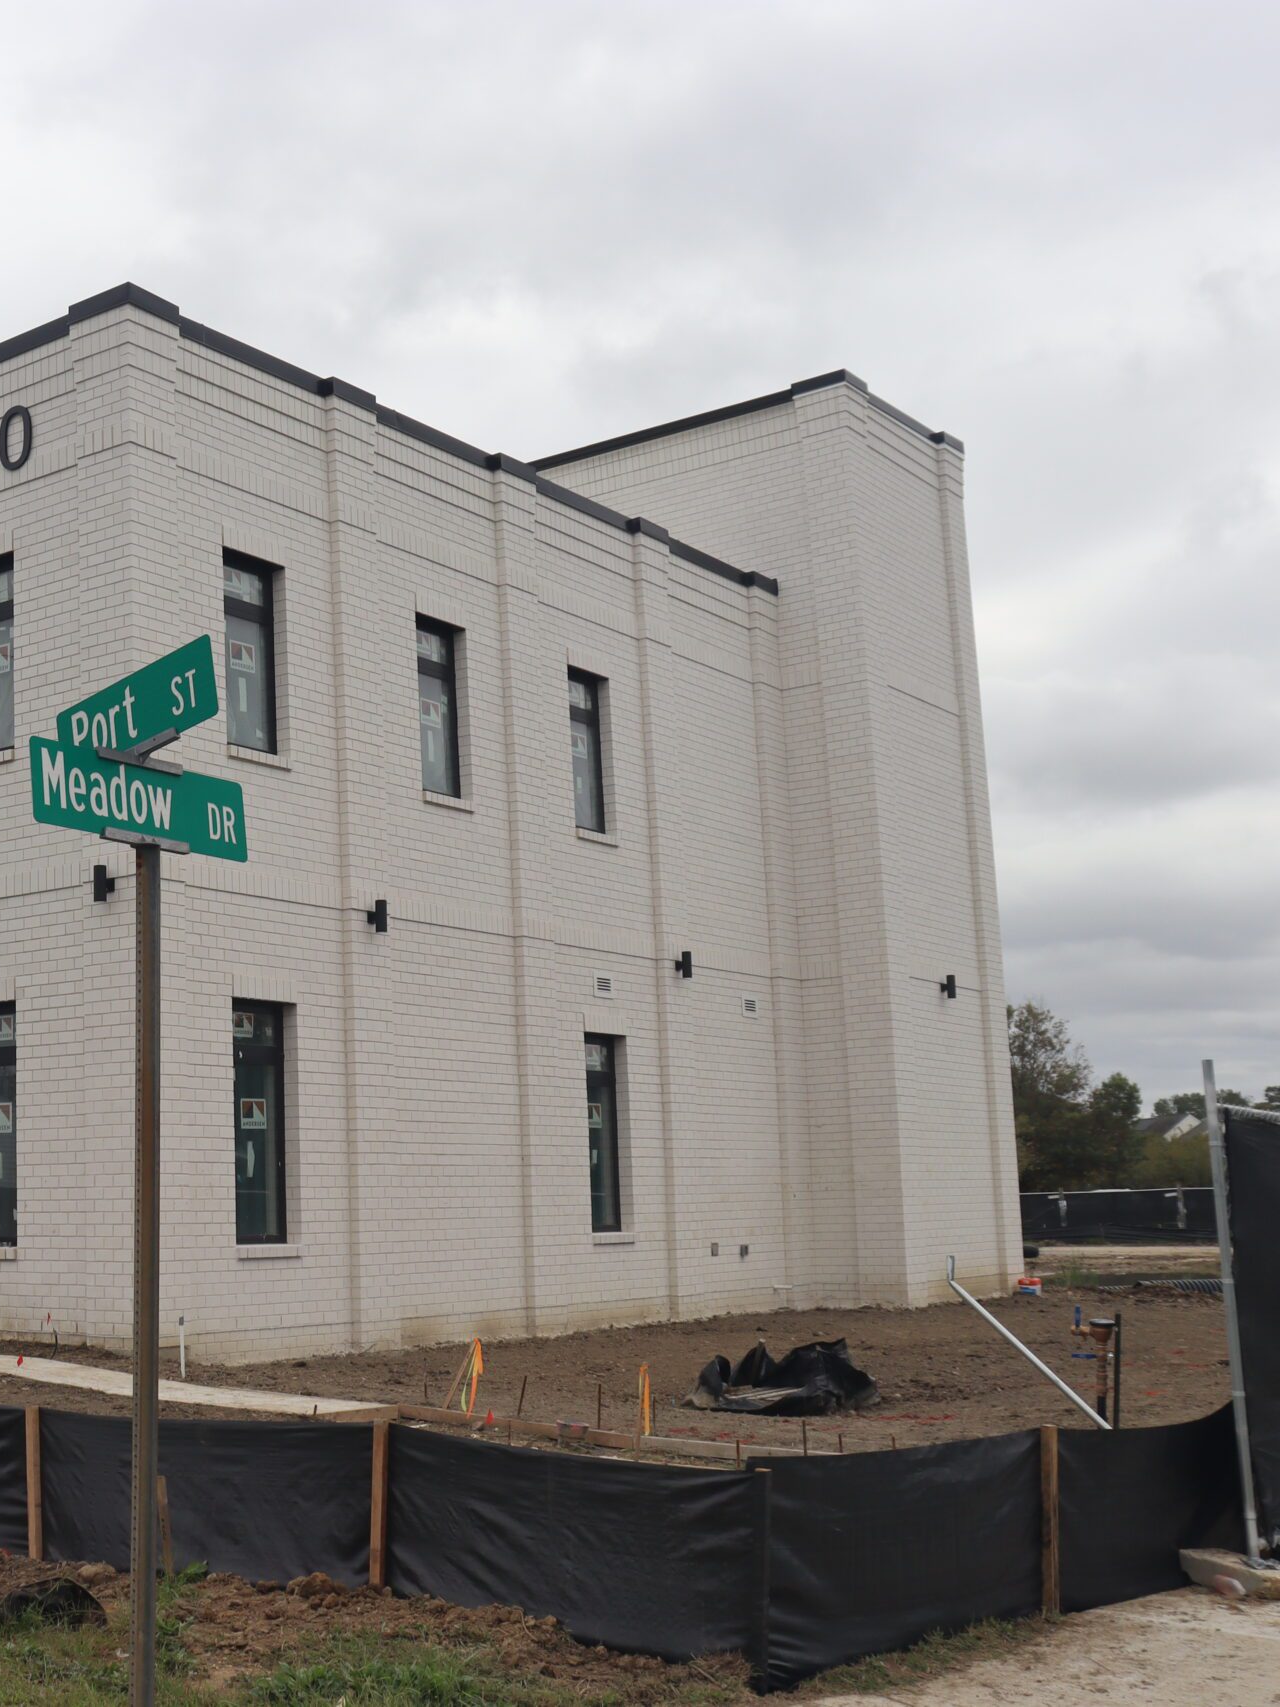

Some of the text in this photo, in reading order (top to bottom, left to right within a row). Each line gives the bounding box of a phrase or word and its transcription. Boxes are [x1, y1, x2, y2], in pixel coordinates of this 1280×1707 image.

[71, 669, 196, 749] Port ST
[41, 747, 237, 845] Meadow DR
